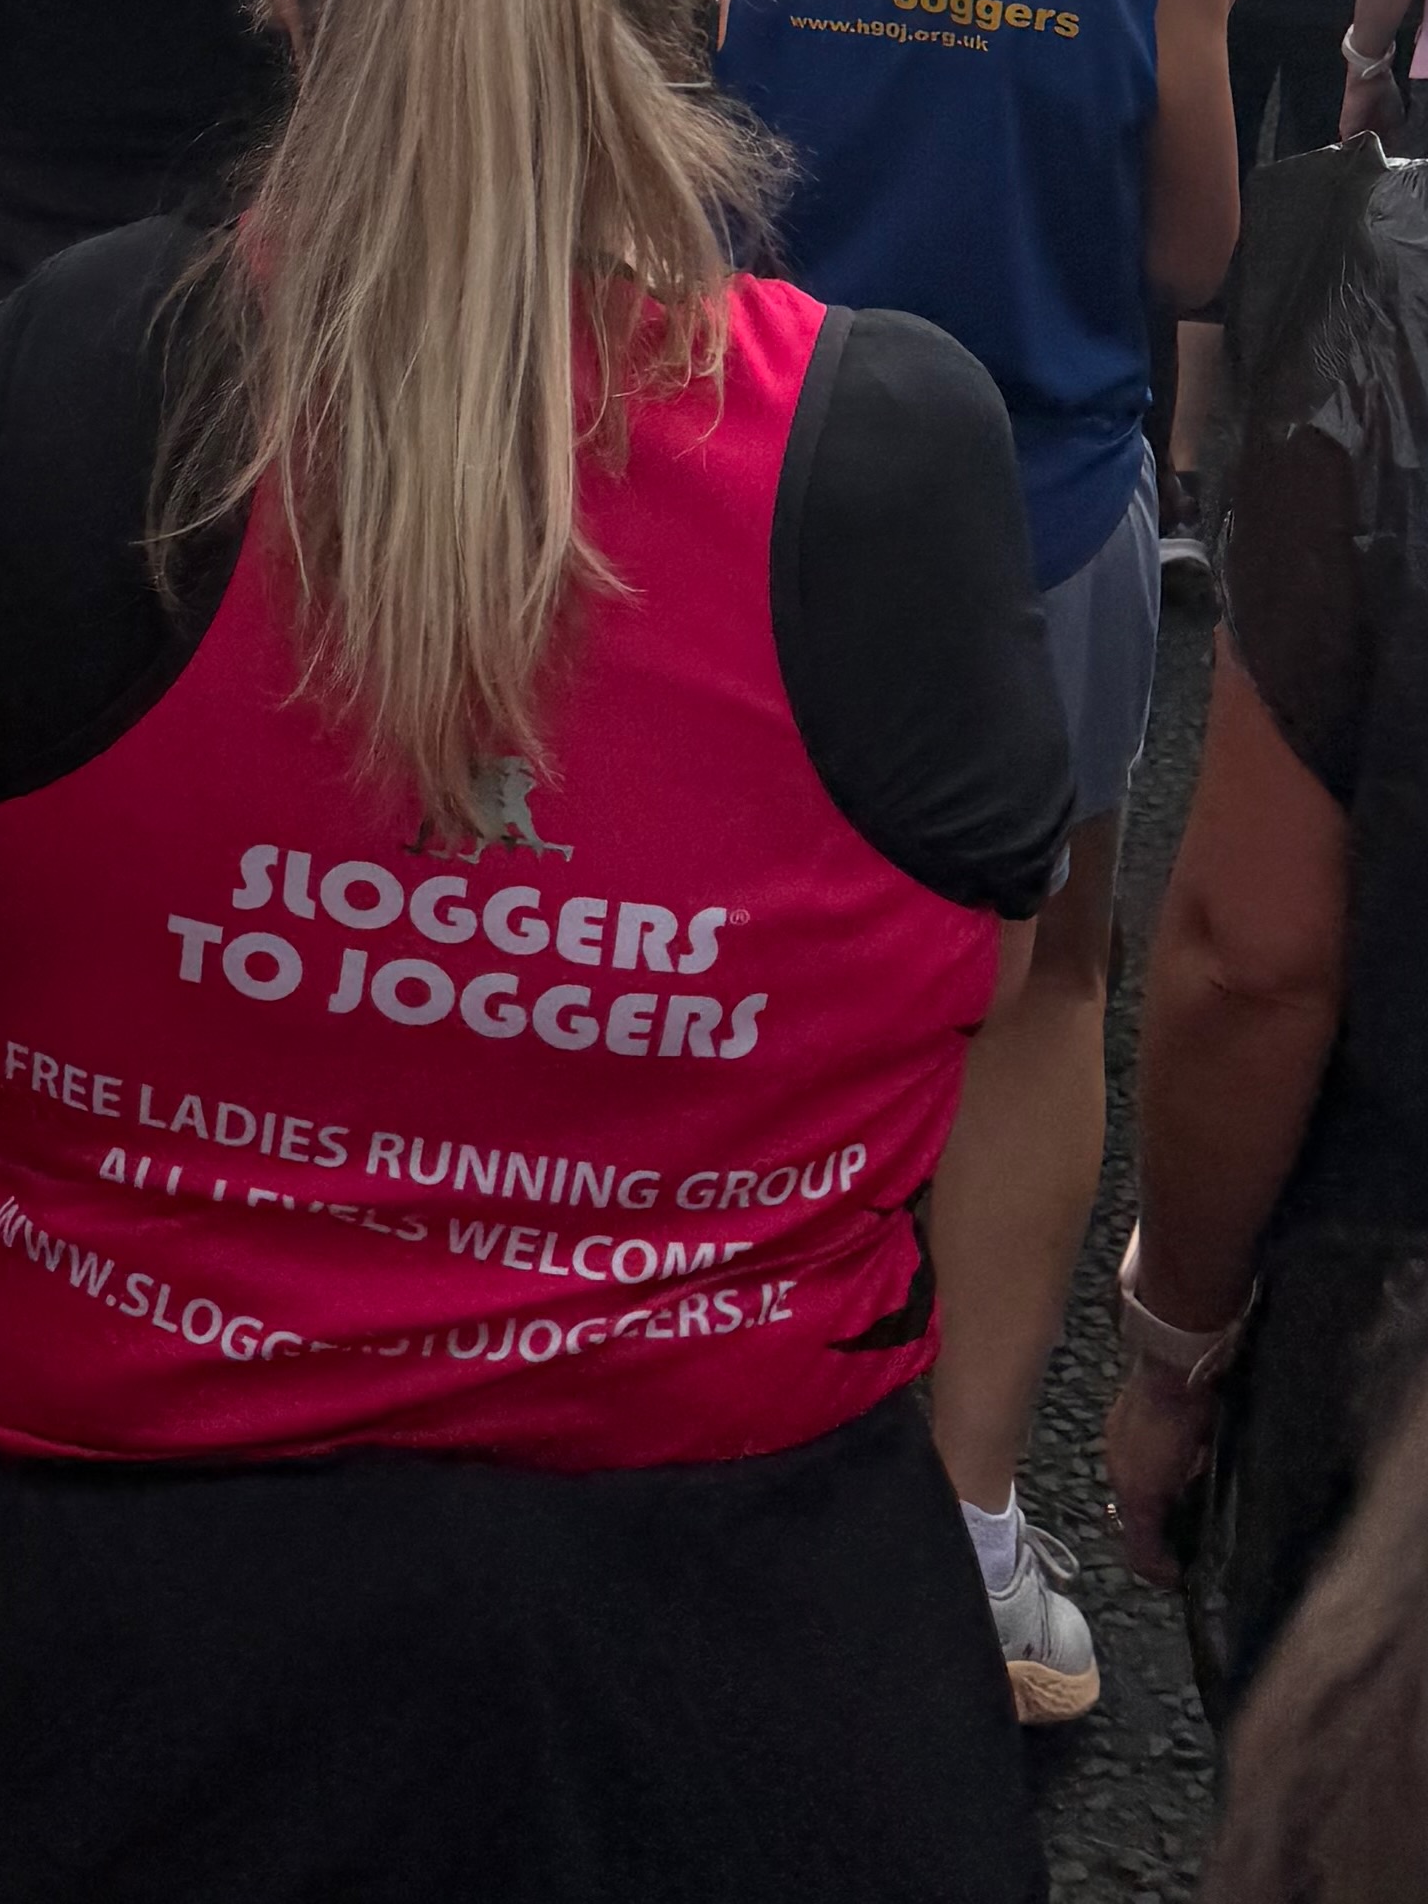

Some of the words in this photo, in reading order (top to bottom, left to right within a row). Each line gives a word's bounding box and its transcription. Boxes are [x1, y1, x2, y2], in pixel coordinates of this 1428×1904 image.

[789, 14, 990, 53] www.h90j.org.uk
[166, 913, 304, 1003] TO
[327, 947, 769, 1061] JOGGERS
[4, 1040, 124, 1120] FREE
[137, 1082, 352, 1169] LADIES
[364, 1129, 662, 1211] RUNNING
[674, 1142, 868, 1212] GROUP
